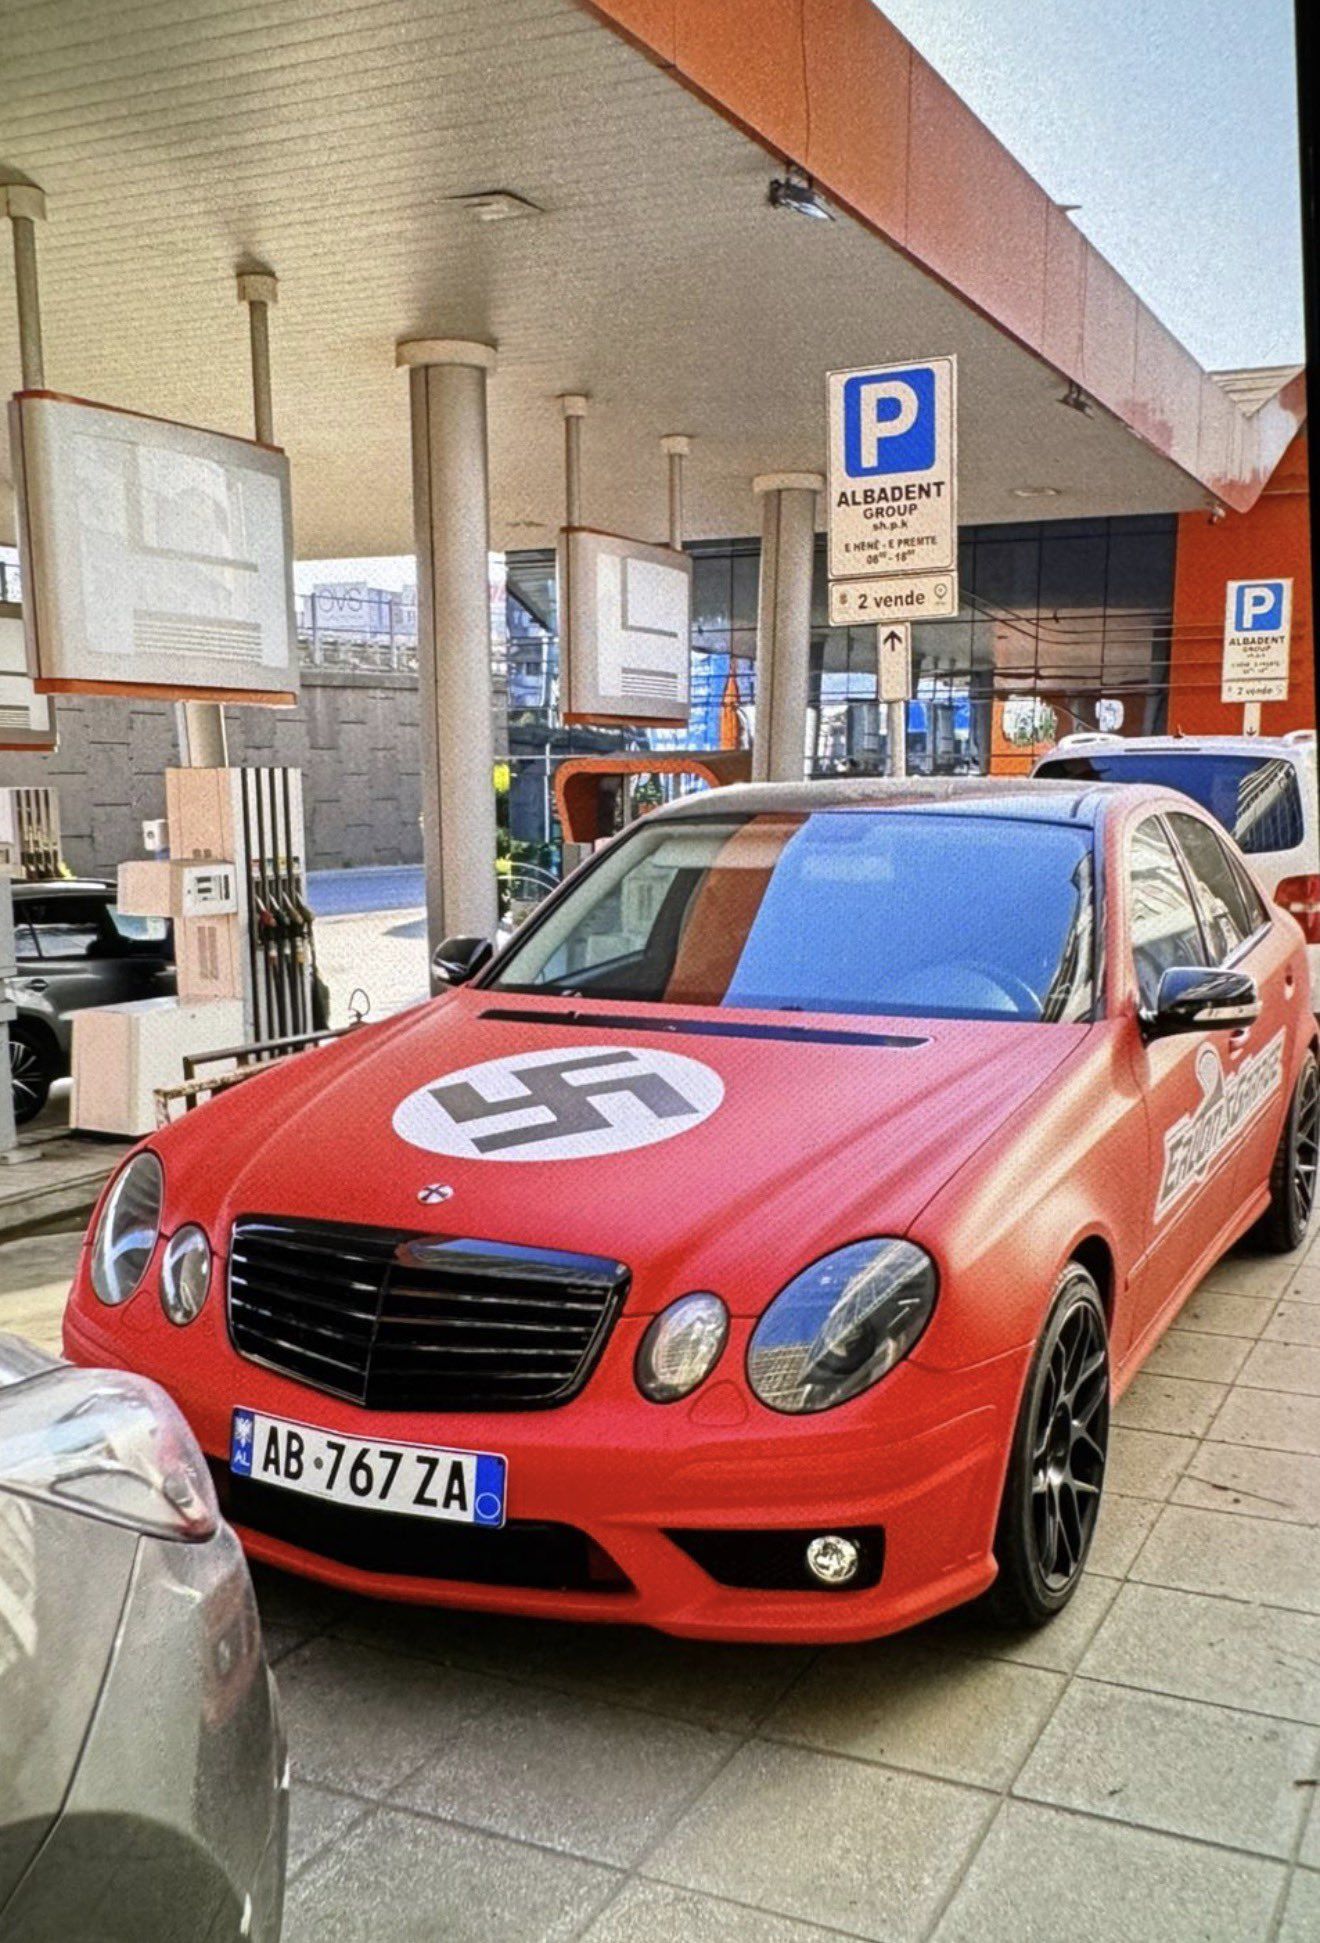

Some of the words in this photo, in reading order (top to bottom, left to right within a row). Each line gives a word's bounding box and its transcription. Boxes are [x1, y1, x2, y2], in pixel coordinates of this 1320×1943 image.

[861, 380, 919, 468] P
[837, 481, 945, 507] ALBADENT
[863, 503, 918, 519] GROUP
[873, 521, 908, 531] sh.p.k
[844, 543, 850, 552] E
[888, 539, 893, 549] E
[897, 535, 937, 547] PREMTE
[858, 594, 868, 609] 2
[874, 590, 925, 608] vende
[1243, 587, 1275, 628] P
[1229, 636, 1285, 646] ALBADENT
[234, 1449, 250, 1466] AL
[262, 1426, 304, 1480] AB
[326, 1440, 403, 1500] 767
[412, 1455, 468, 1512] ZA
